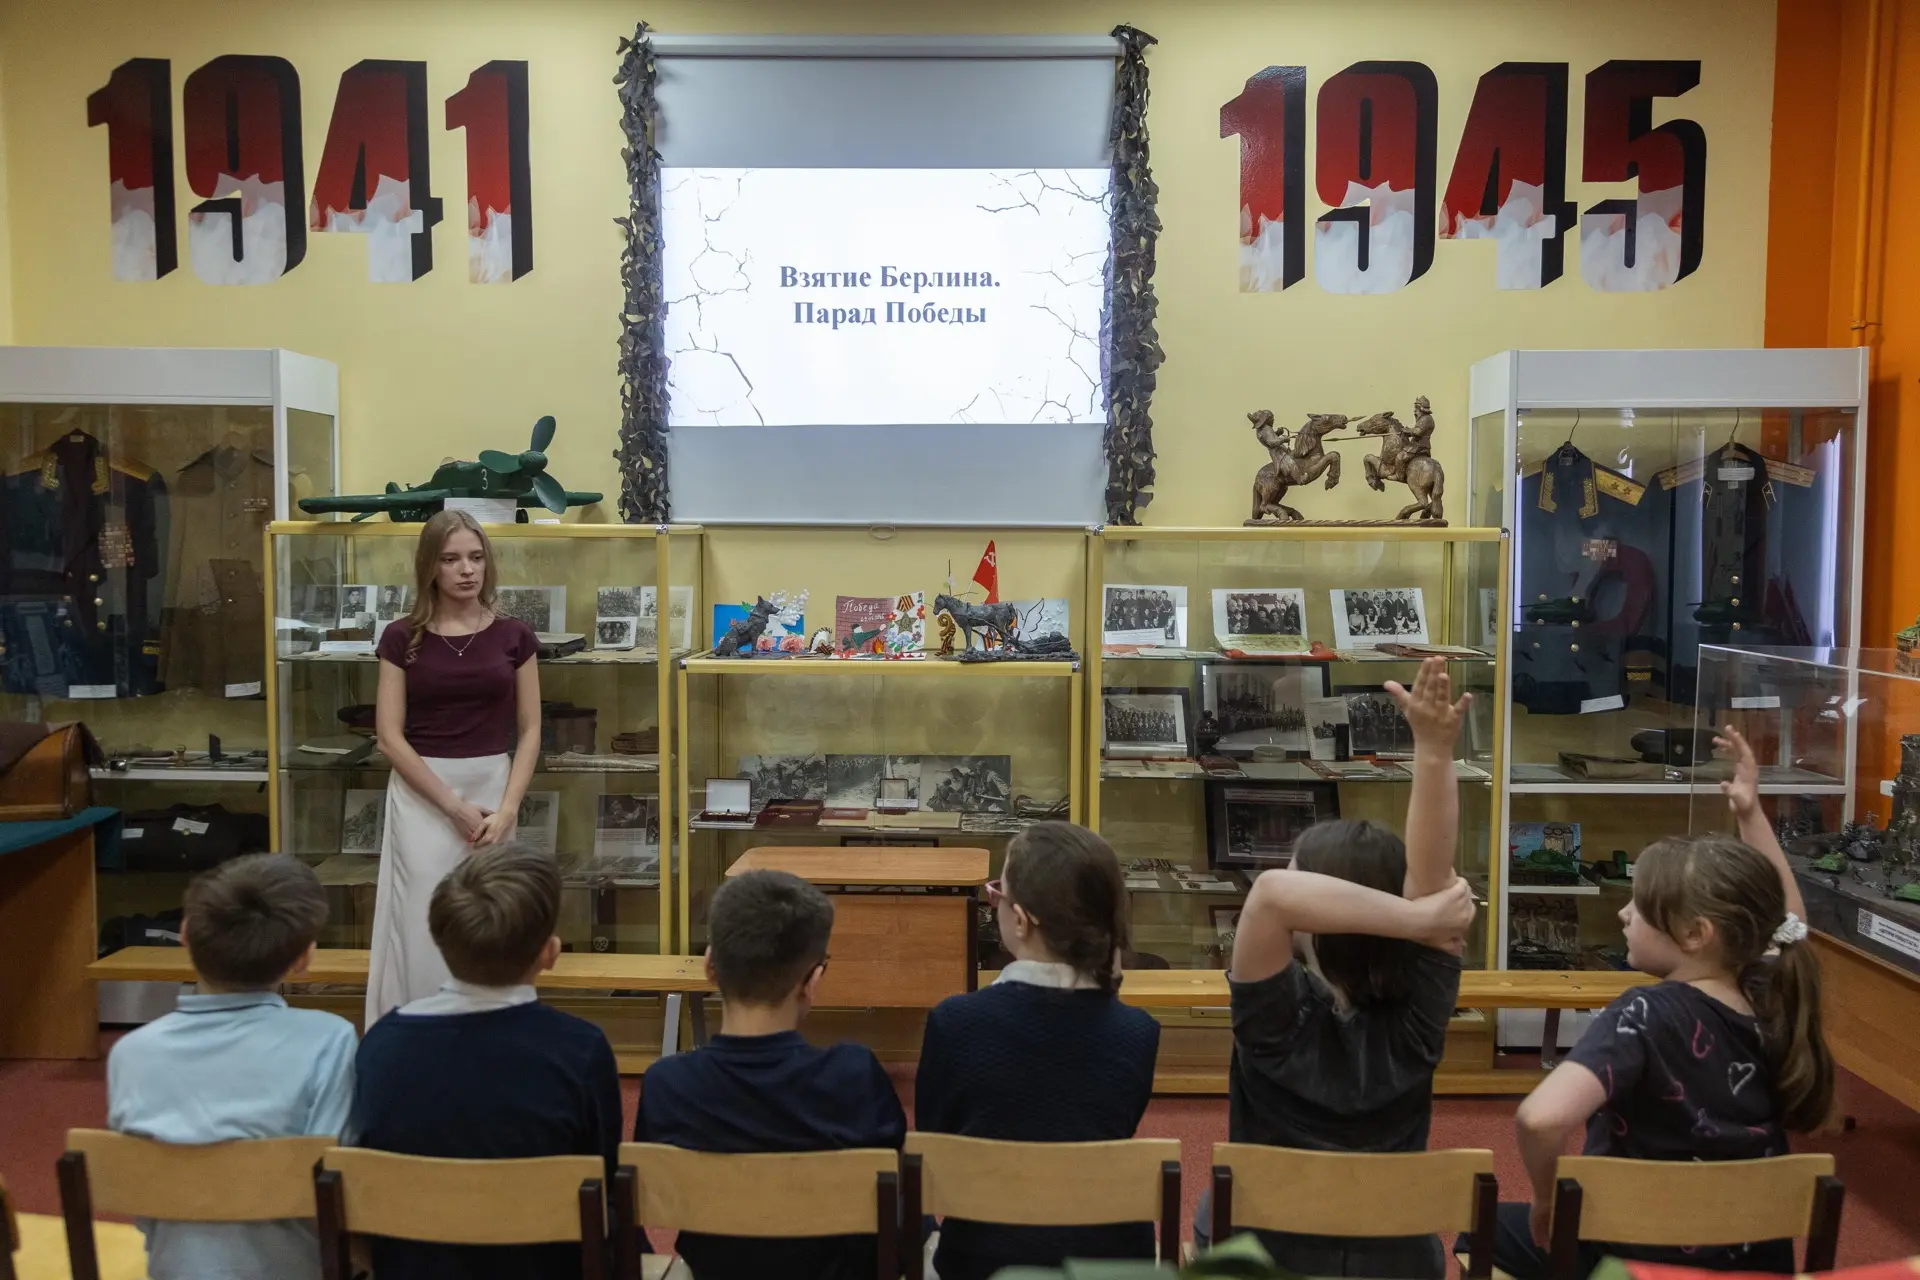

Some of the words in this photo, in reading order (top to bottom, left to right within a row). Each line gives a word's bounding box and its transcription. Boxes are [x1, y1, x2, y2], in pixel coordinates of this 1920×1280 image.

[87, 54, 533, 285] 1941
[1219, 59, 1707, 295] 1945
[779, 265, 872, 288] Взятие
[879, 265, 1001, 294] Берлина.
[793, 301, 877, 330] Парад
[884, 301, 987, 326] Победы
[481, 468, 489, 490] 3
